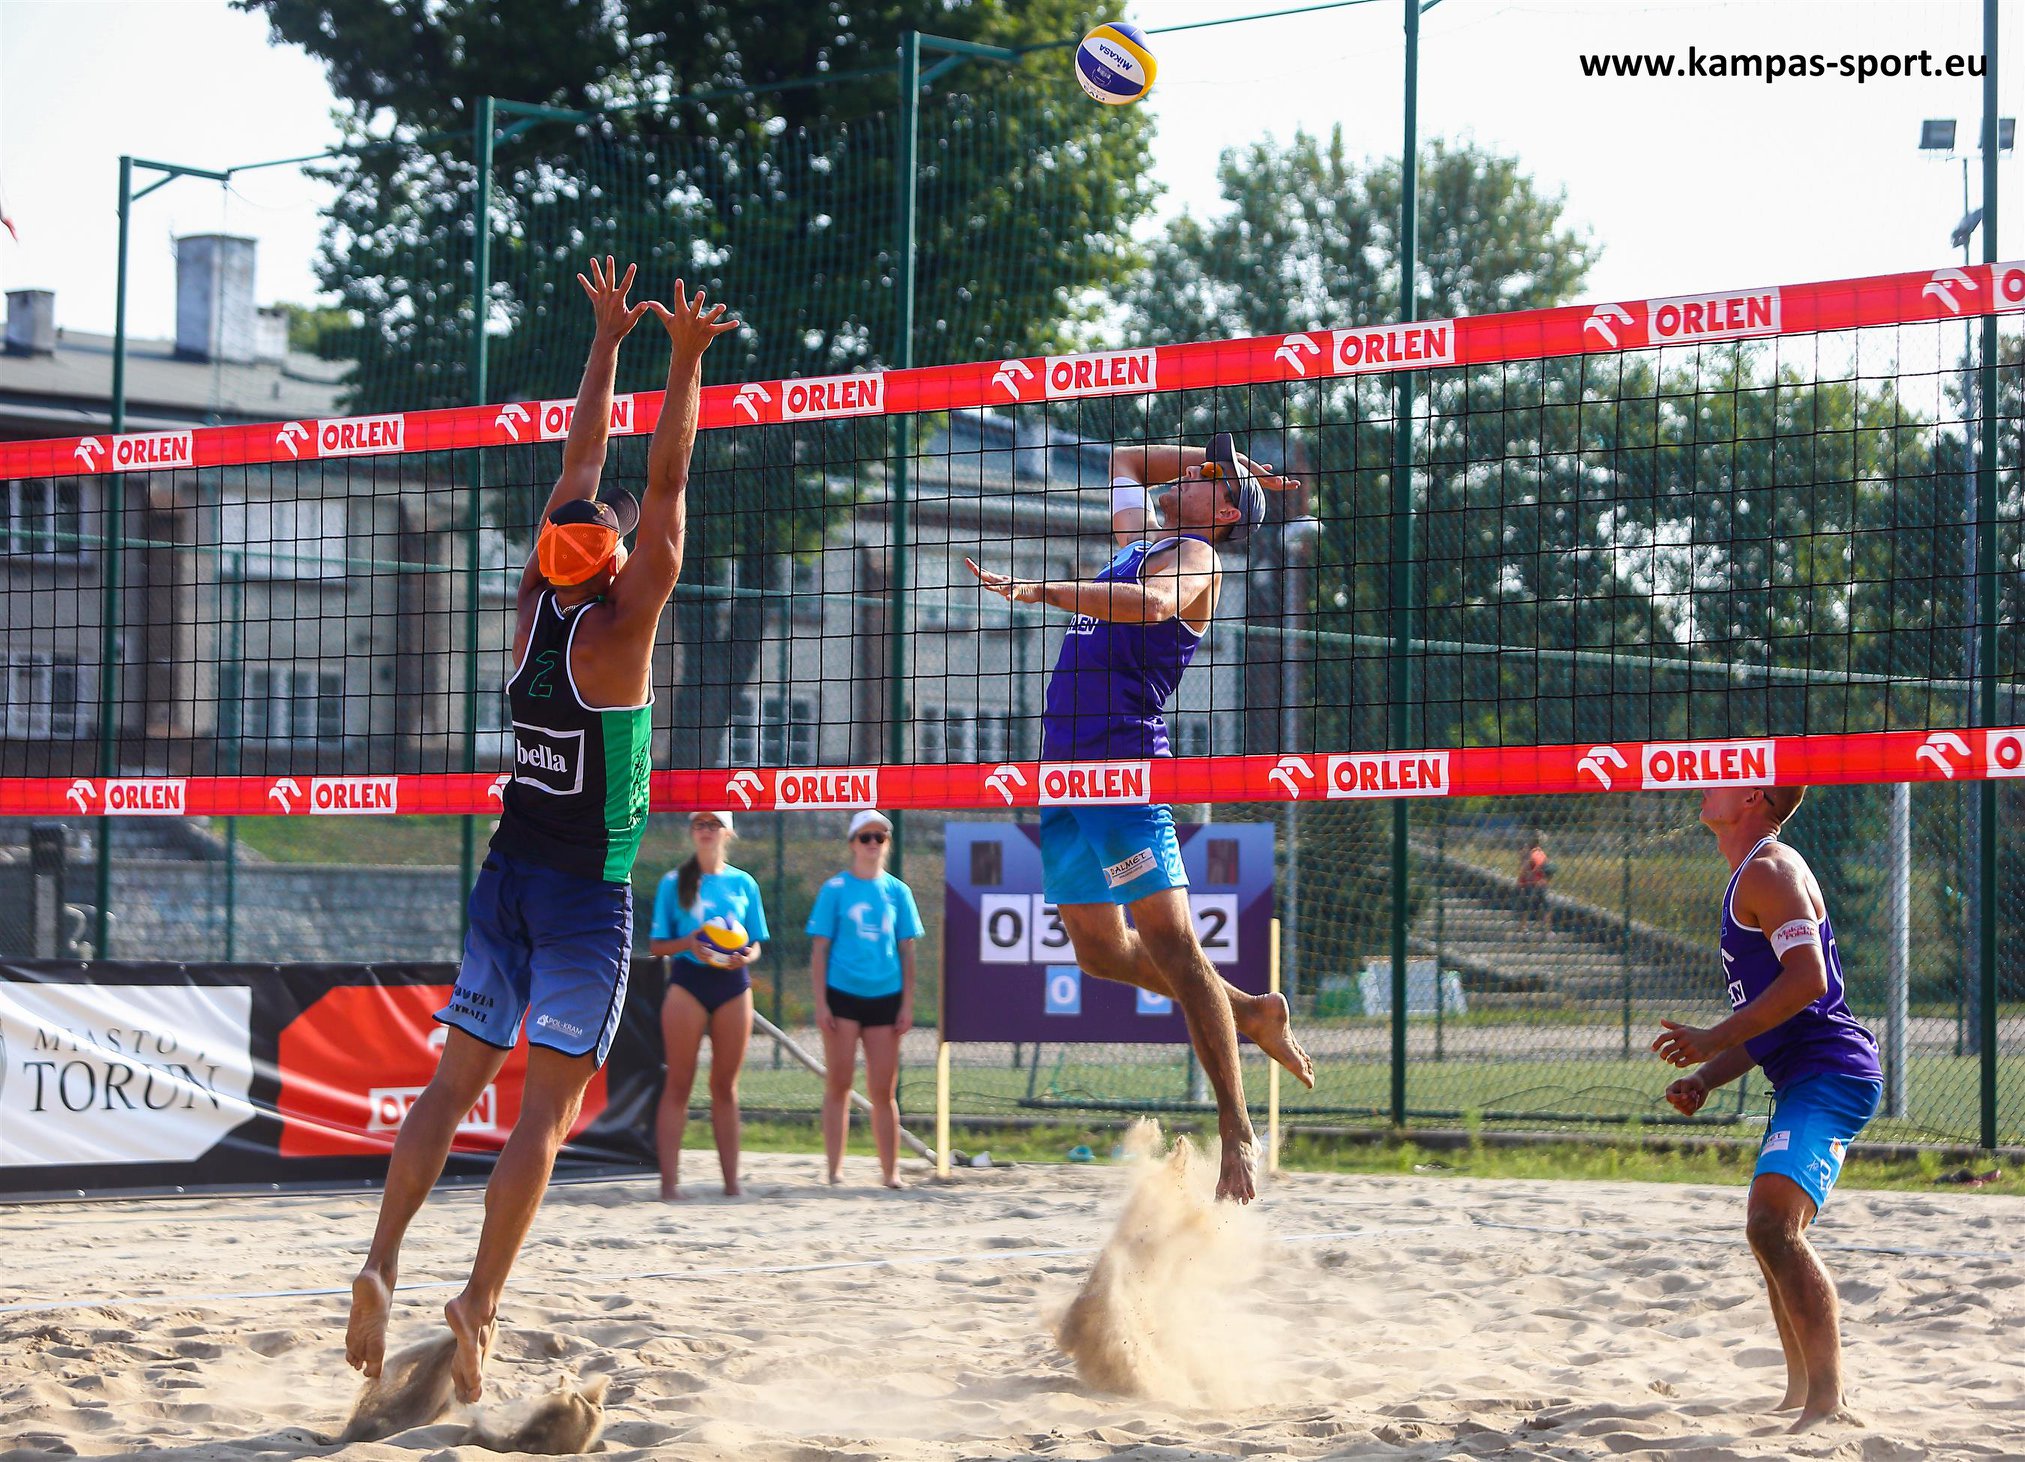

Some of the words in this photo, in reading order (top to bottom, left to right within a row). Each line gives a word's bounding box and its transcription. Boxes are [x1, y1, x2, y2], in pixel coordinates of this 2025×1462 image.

[1655, 296, 1774, 336] ORLEN
[1340, 328, 1447, 366] ORLEN
[1051, 355, 1149, 391] ORLEN
[788, 379, 878, 413] ORLEN
[116, 437, 188, 464] ORLEN
[323, 420, 399, 450] ORLEN
[529, 650, 561, 698] 2
[516, 739, 567, 773] bella
[1649, 748, 1767, 782] ORLEN
[781, 774, 871, 803] ORLEN
[1044, 768, 1143, 799] ORLEN
[1334, 759, 1441, 791] ORLEN
[108, 784, 181, 810] ORLEN
[315, 782, 392, 809] ORLEN
